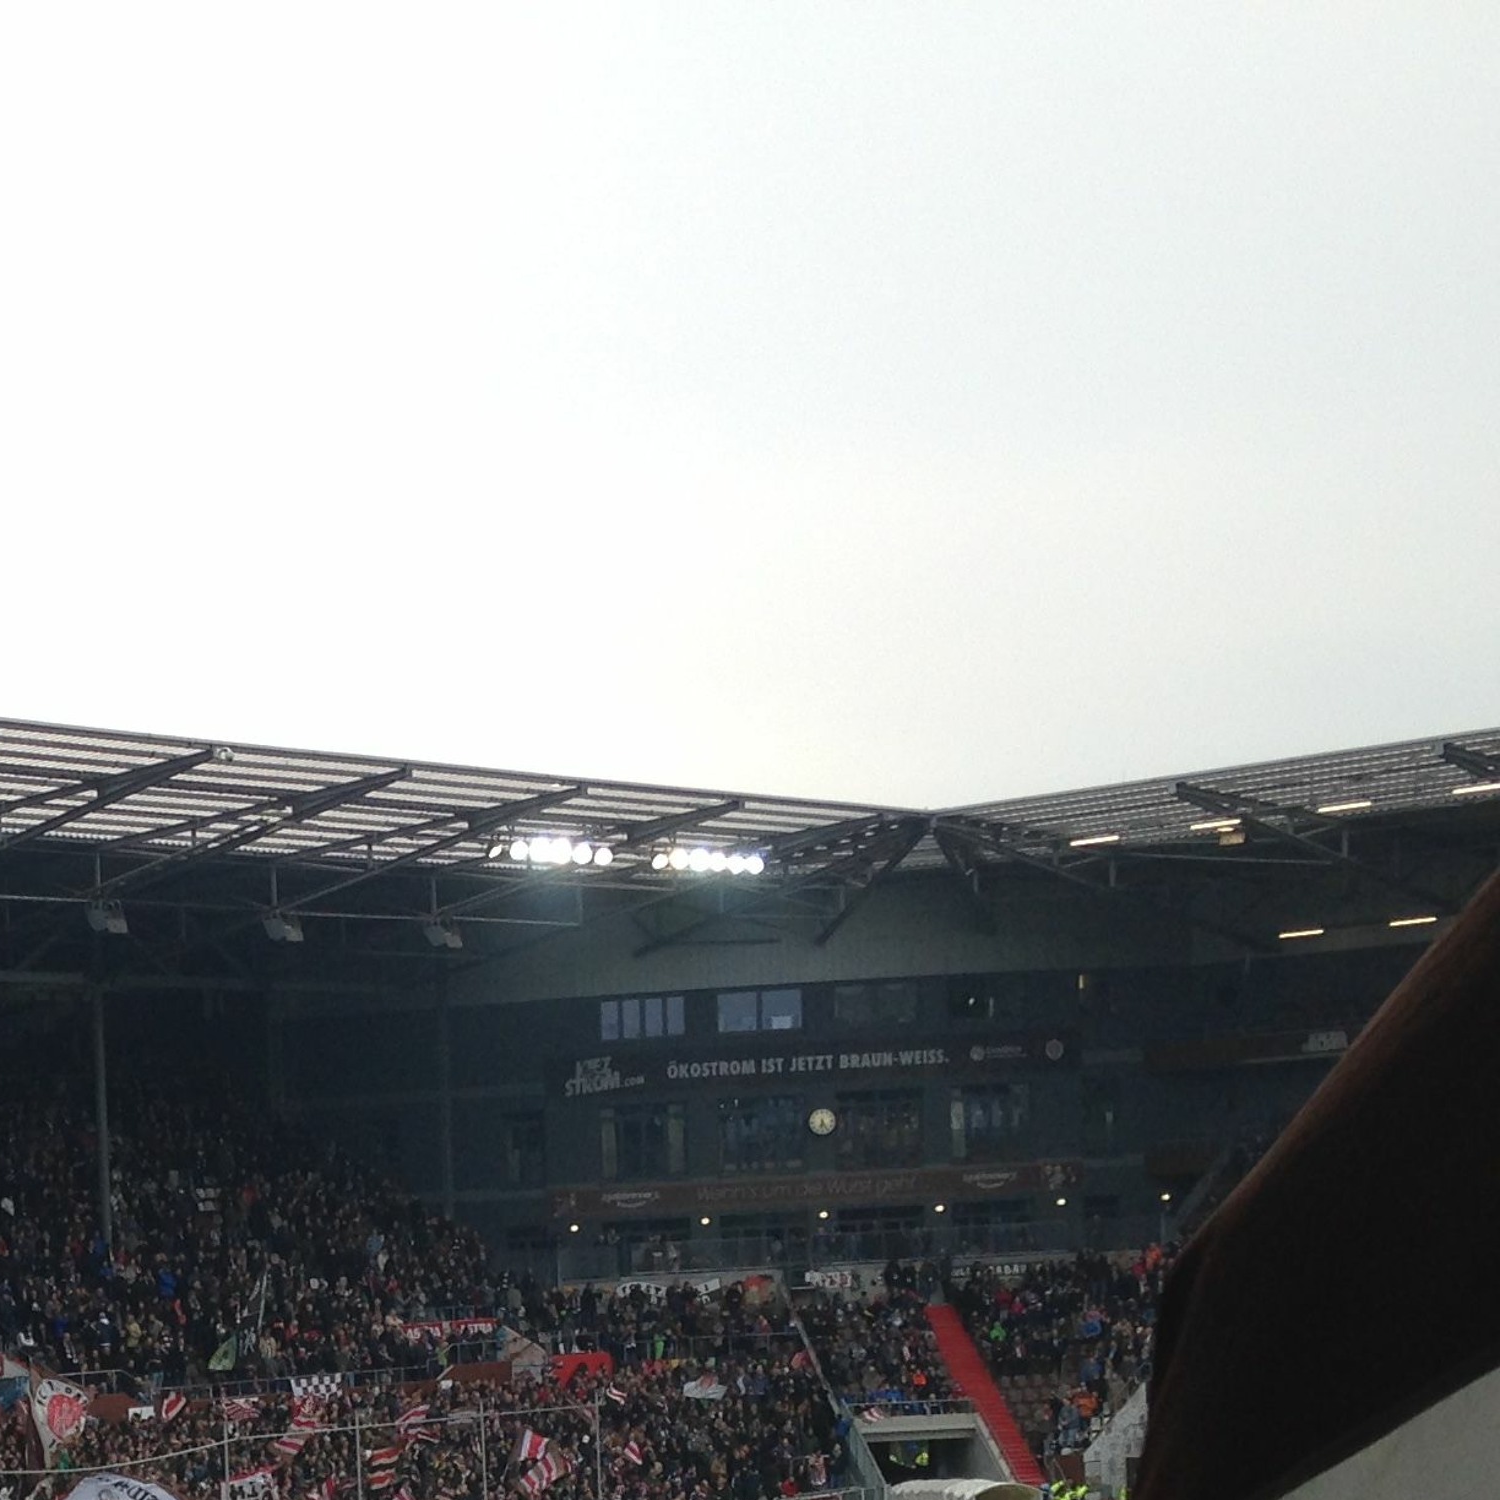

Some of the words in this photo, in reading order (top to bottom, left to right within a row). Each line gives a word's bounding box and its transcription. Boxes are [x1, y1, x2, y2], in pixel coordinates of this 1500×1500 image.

[667, 1060, 756, 1079] ÖKOSTROM
[761, 1057, 784, 1074] IST
[789, 1054, 833, 1072] JETZT
